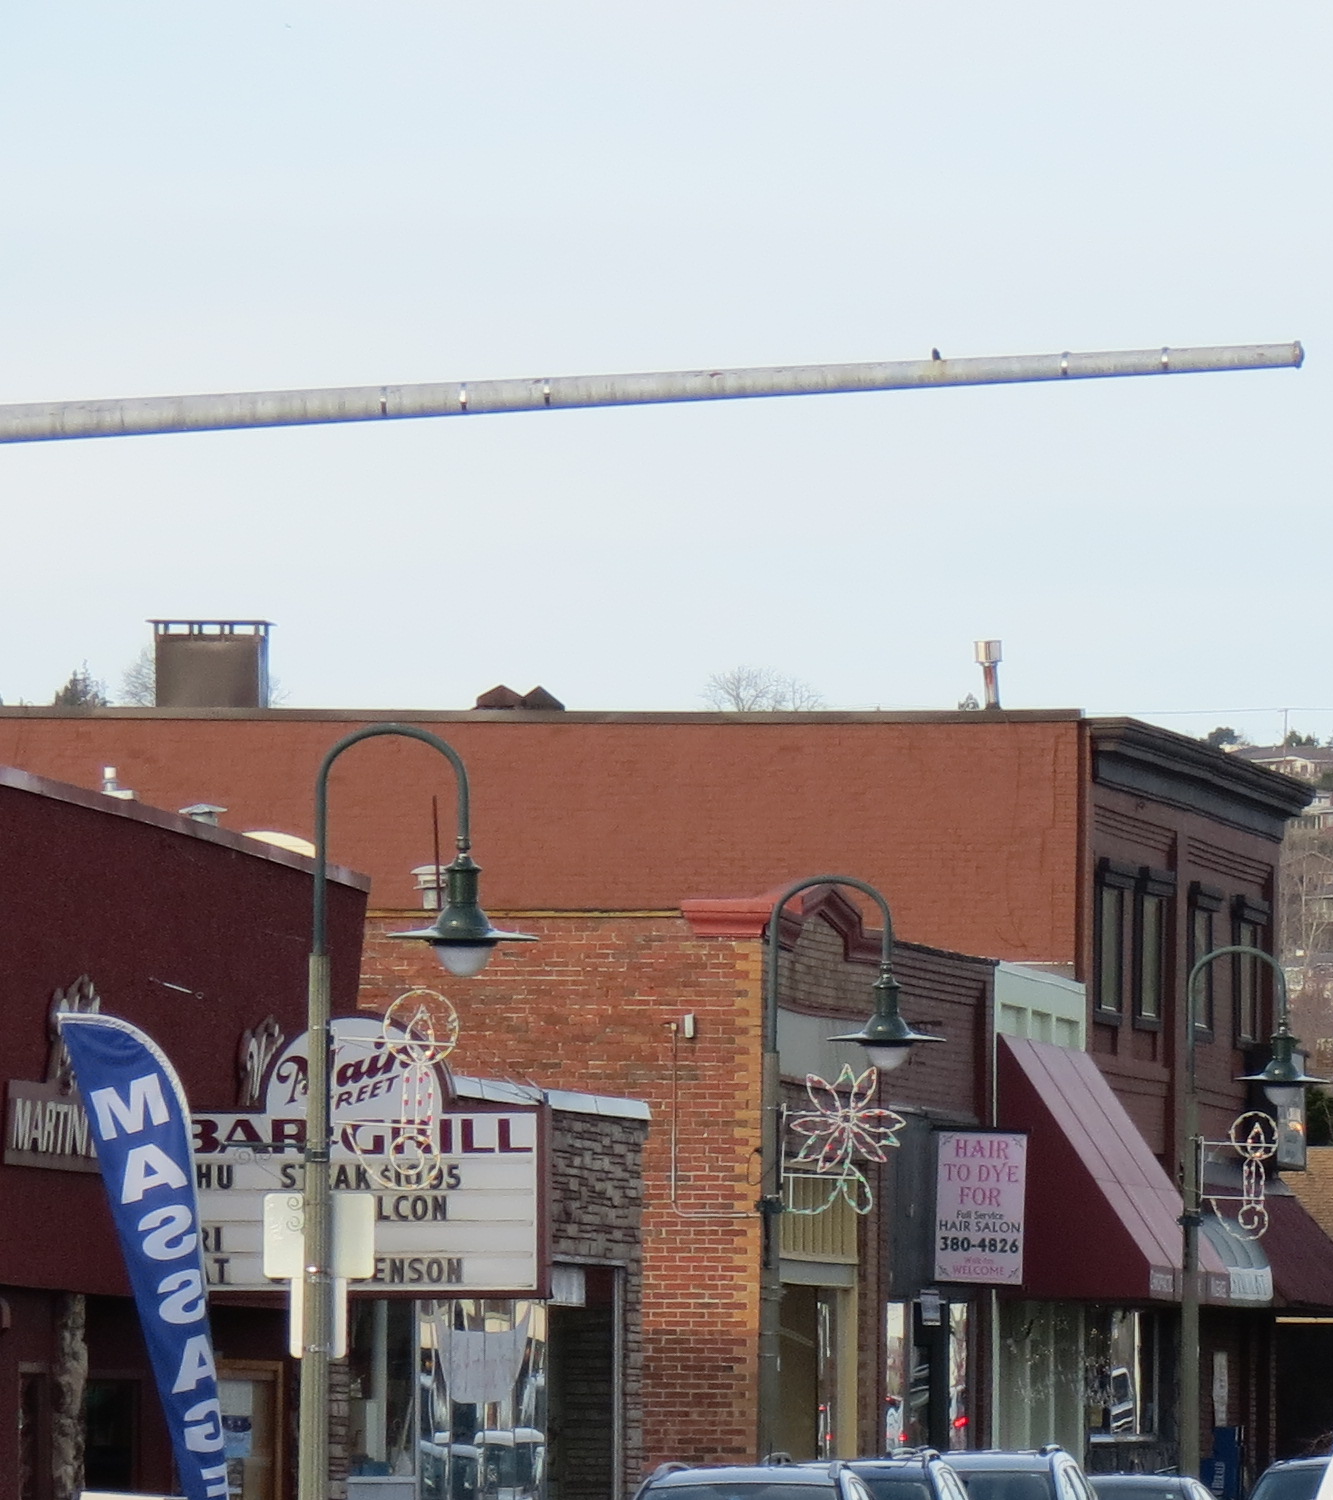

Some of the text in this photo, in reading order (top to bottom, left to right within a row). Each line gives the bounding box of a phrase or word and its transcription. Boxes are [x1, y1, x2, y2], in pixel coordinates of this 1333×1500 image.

[334, 1073, 401, 1111] REET
[955, 1138, 1009, 1160] HAIR
[197, 1164, 234, 1190] HU
[943, 1162, 1019, 1183] TO DYE
[959, 1186, 1001, 1207] FOR
[376, 1194, 448, 1221] LCON
[956, 1210, 1004, 1221] Full Service
[939, 1220, 1021, 1233] HAIR SALON
[939, 1236, 1020, 1254] 380-4826
[374, 1257, 463, 1284] ENSON
[952, 1264, 1005, 1277] WELCOME
